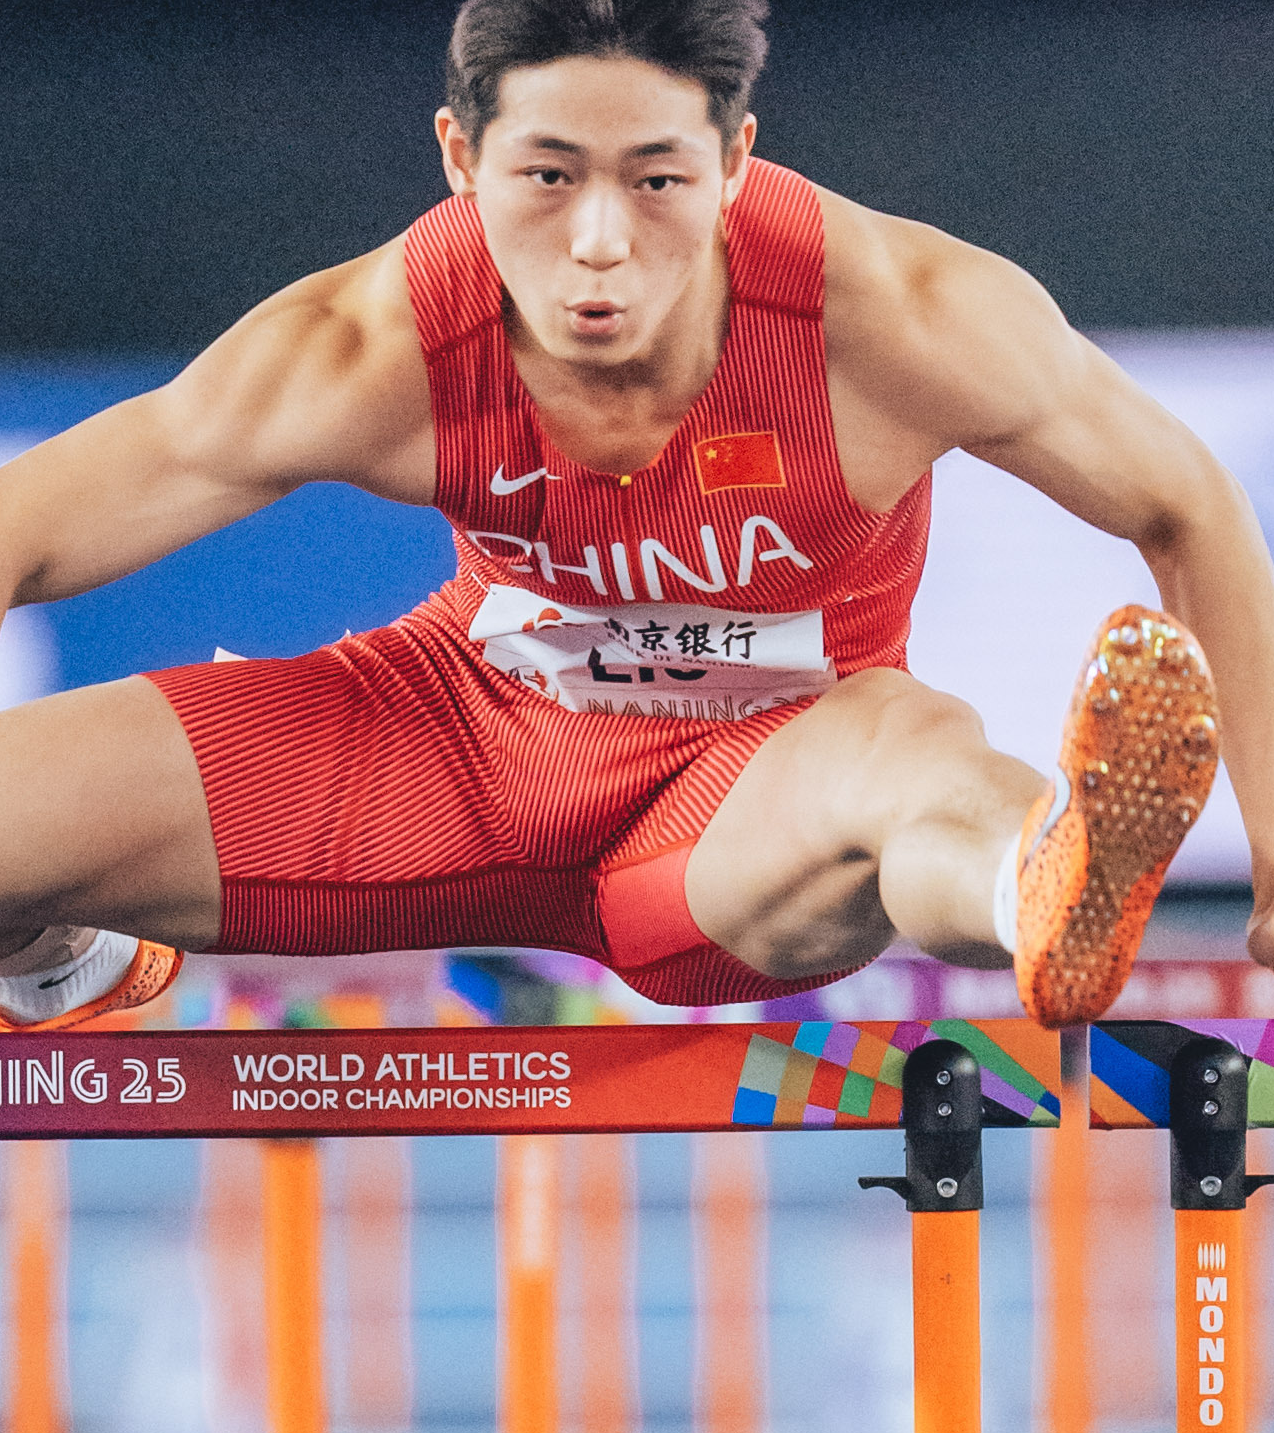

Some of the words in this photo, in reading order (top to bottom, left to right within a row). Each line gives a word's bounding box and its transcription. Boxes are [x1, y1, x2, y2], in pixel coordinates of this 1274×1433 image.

[119, 1057, 188, 1104] 25
[232, 1053, 365, 1083] WORLD
[374, 1050, 572, 1082] ATHLETICS
[232, 1089, 339, 1112] INDOOR
[344, 1085, 572, 1110] CHAMPIONSHIPS
[1195, 1276, 1228, 1427] MONDO
